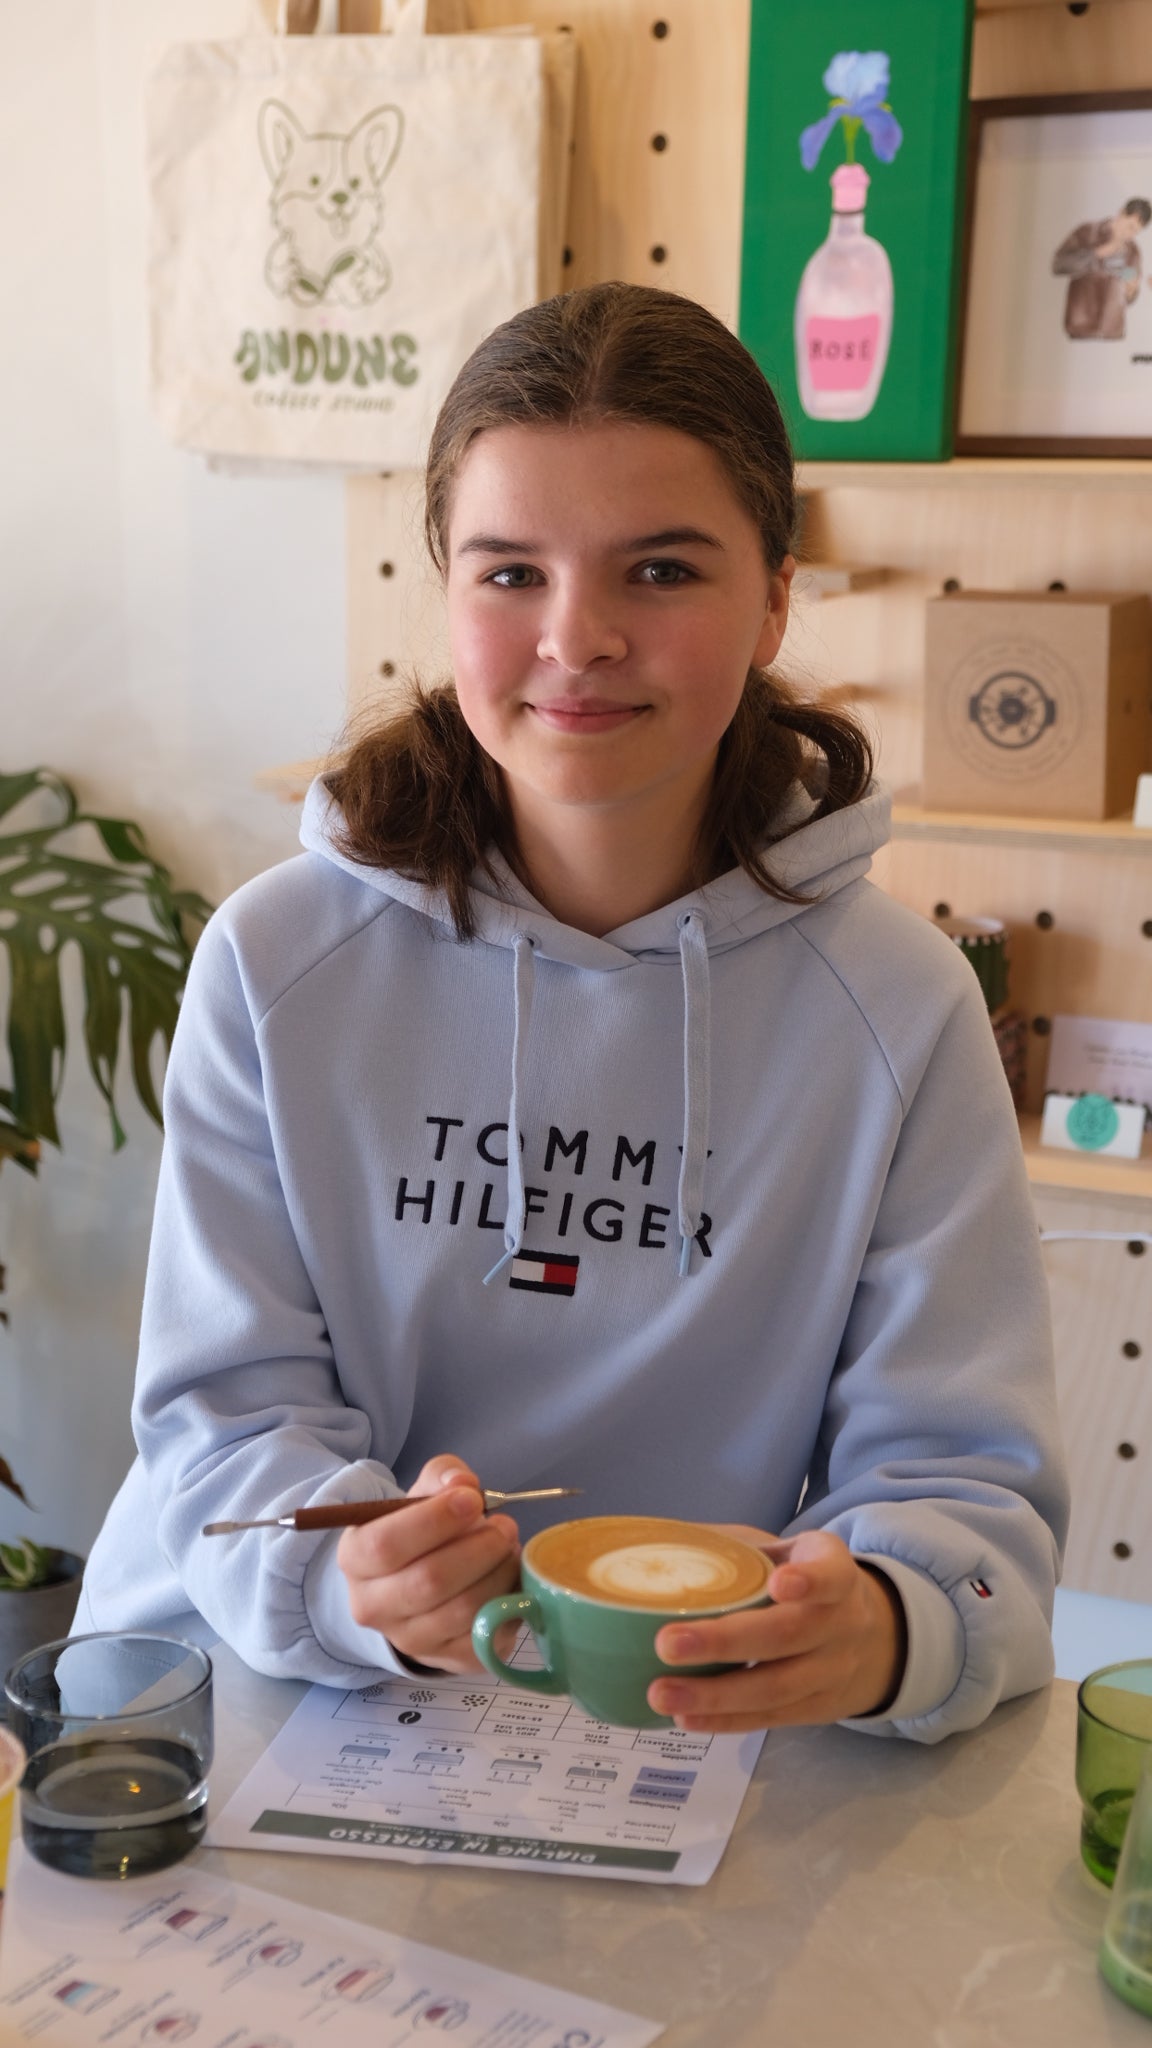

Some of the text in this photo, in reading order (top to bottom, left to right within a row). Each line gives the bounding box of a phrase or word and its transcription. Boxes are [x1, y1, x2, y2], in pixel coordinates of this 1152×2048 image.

[234, 330, 418, 388] ANDUNE
[426, 1117, 712, 1186] TOMM
[395, 1177, 712, 1257] HILFIGER
[329, 1828, 597, 1863] DIALING IN ESPRESSO
